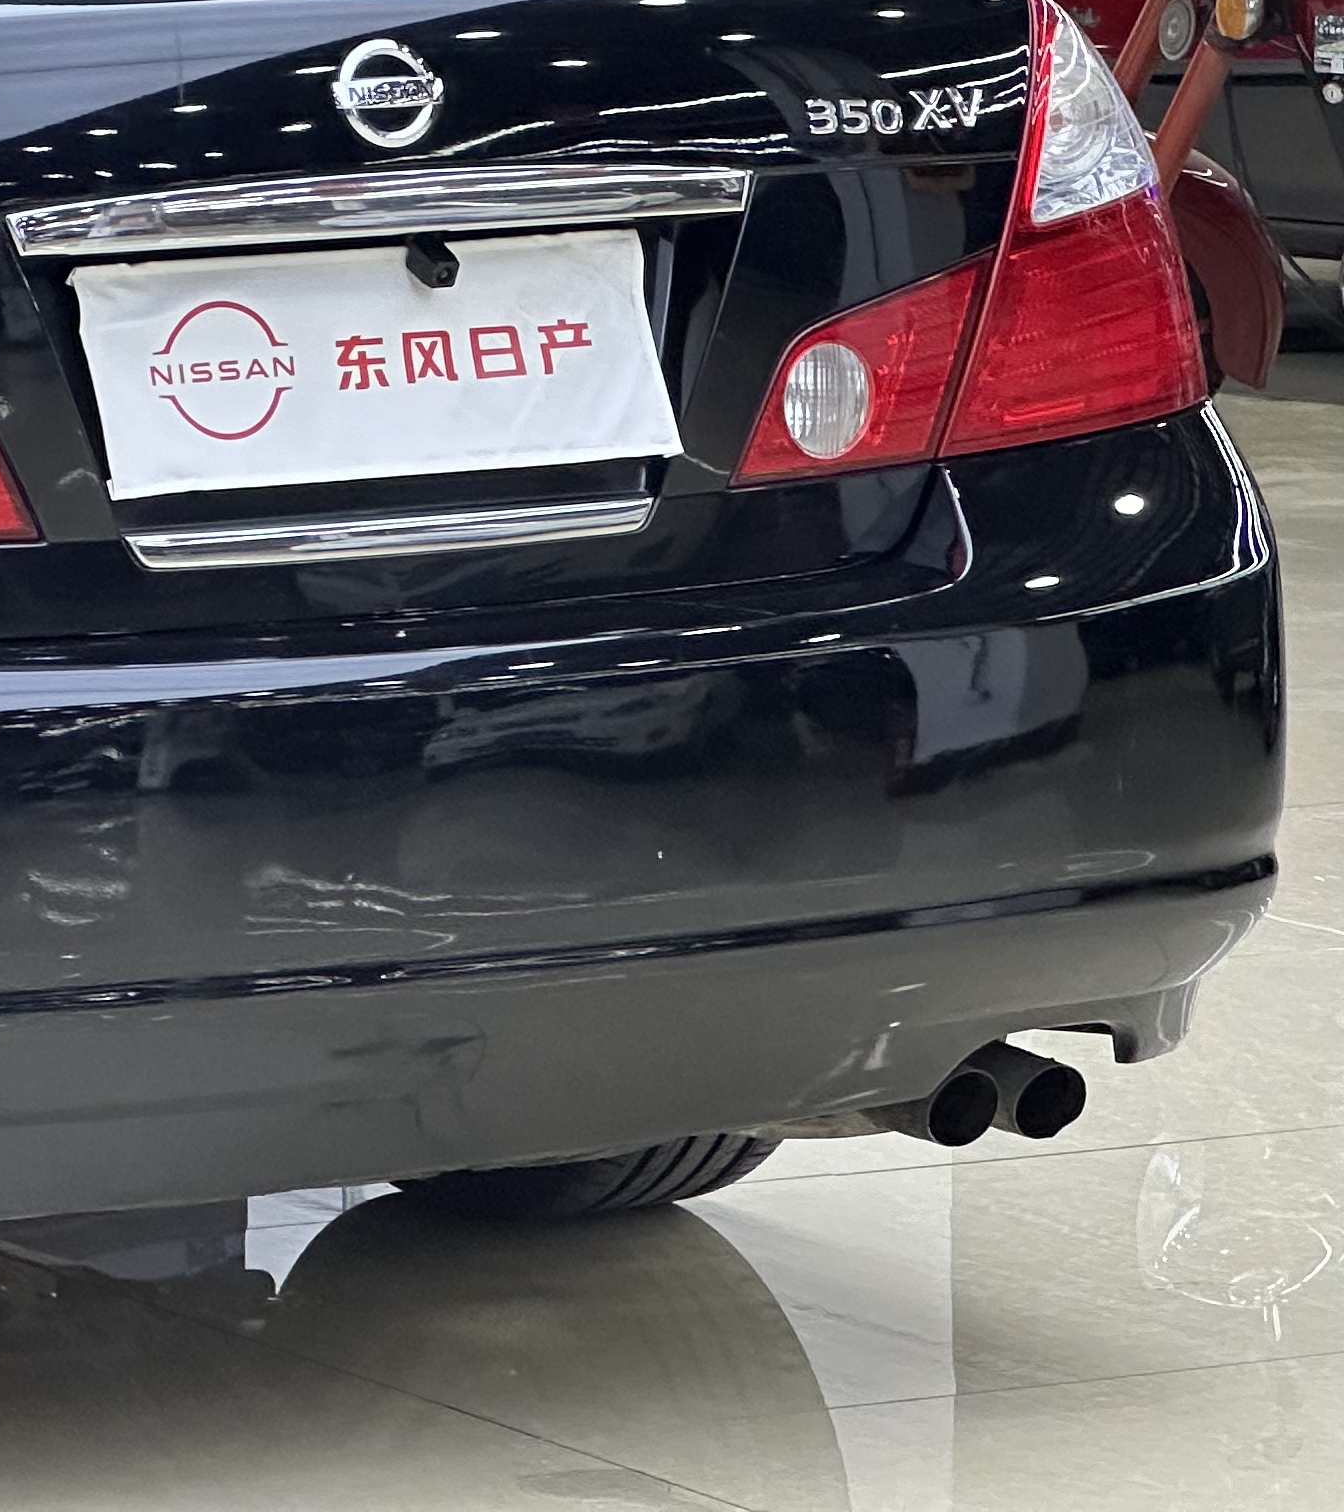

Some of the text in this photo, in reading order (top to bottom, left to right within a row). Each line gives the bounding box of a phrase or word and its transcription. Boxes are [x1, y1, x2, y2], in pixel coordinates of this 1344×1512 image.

[805, 87, 984, 135] 350 XV
[149, 355, 295, 388] NISSAN
[335, 317, 593, 392] 东风日产
